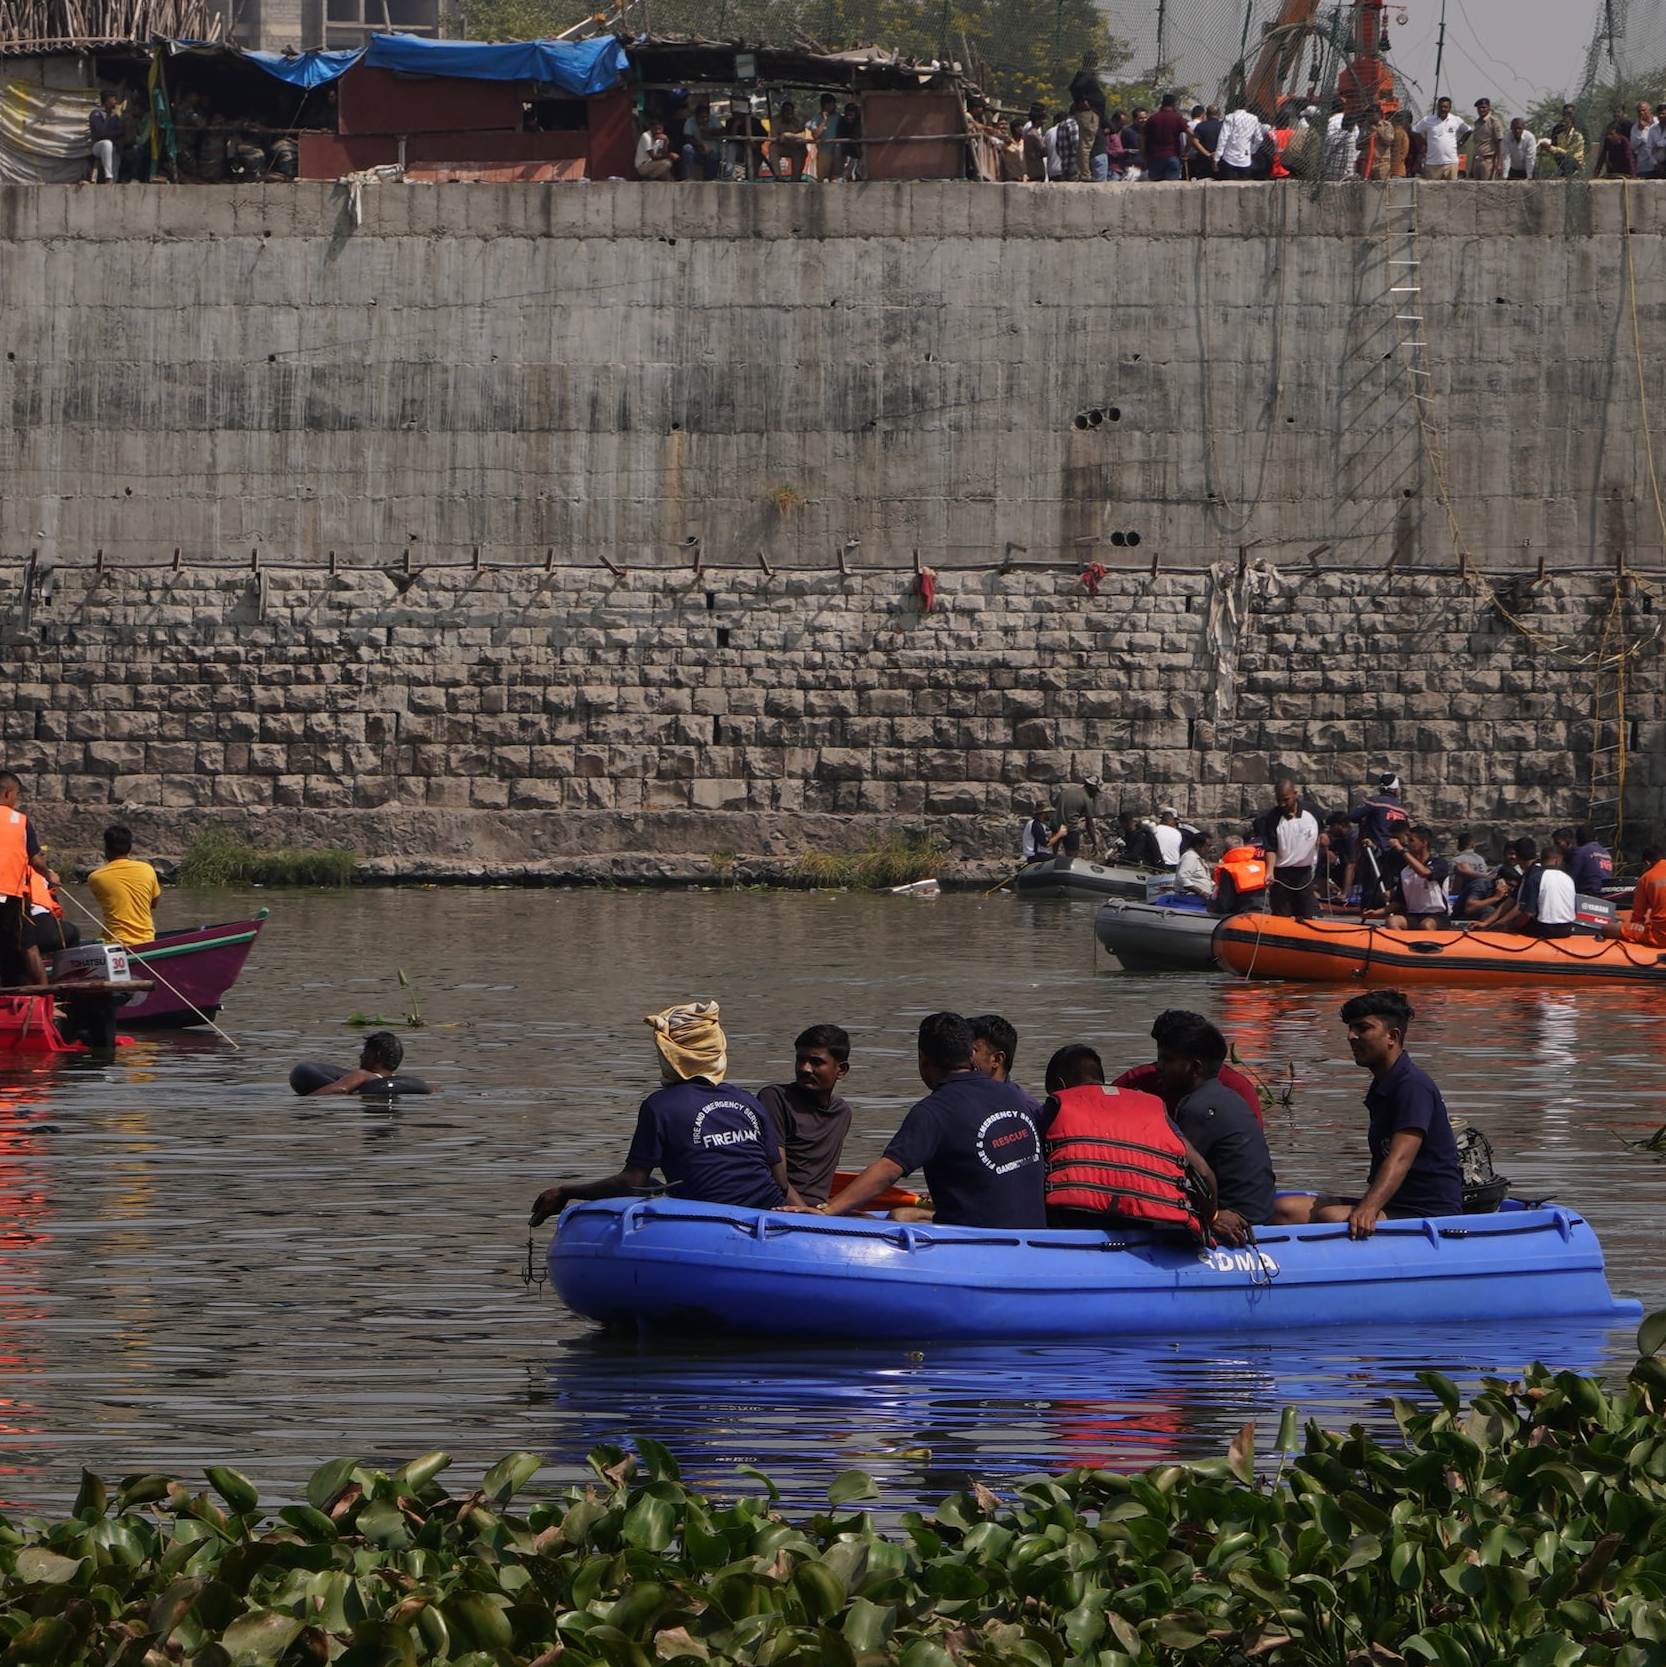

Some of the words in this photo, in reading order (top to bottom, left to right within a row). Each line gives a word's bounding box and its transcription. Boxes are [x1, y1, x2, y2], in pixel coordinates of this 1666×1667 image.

[112, 957, 125, 970] 30
[701, 1101, 745, 1114] EMERGENCY
[977, 1111, 1018, 1139] EMERGENCY
[992, 1129, 1029, 1148] RESCUE
[978, 1150, 996, 1170] FIRE
